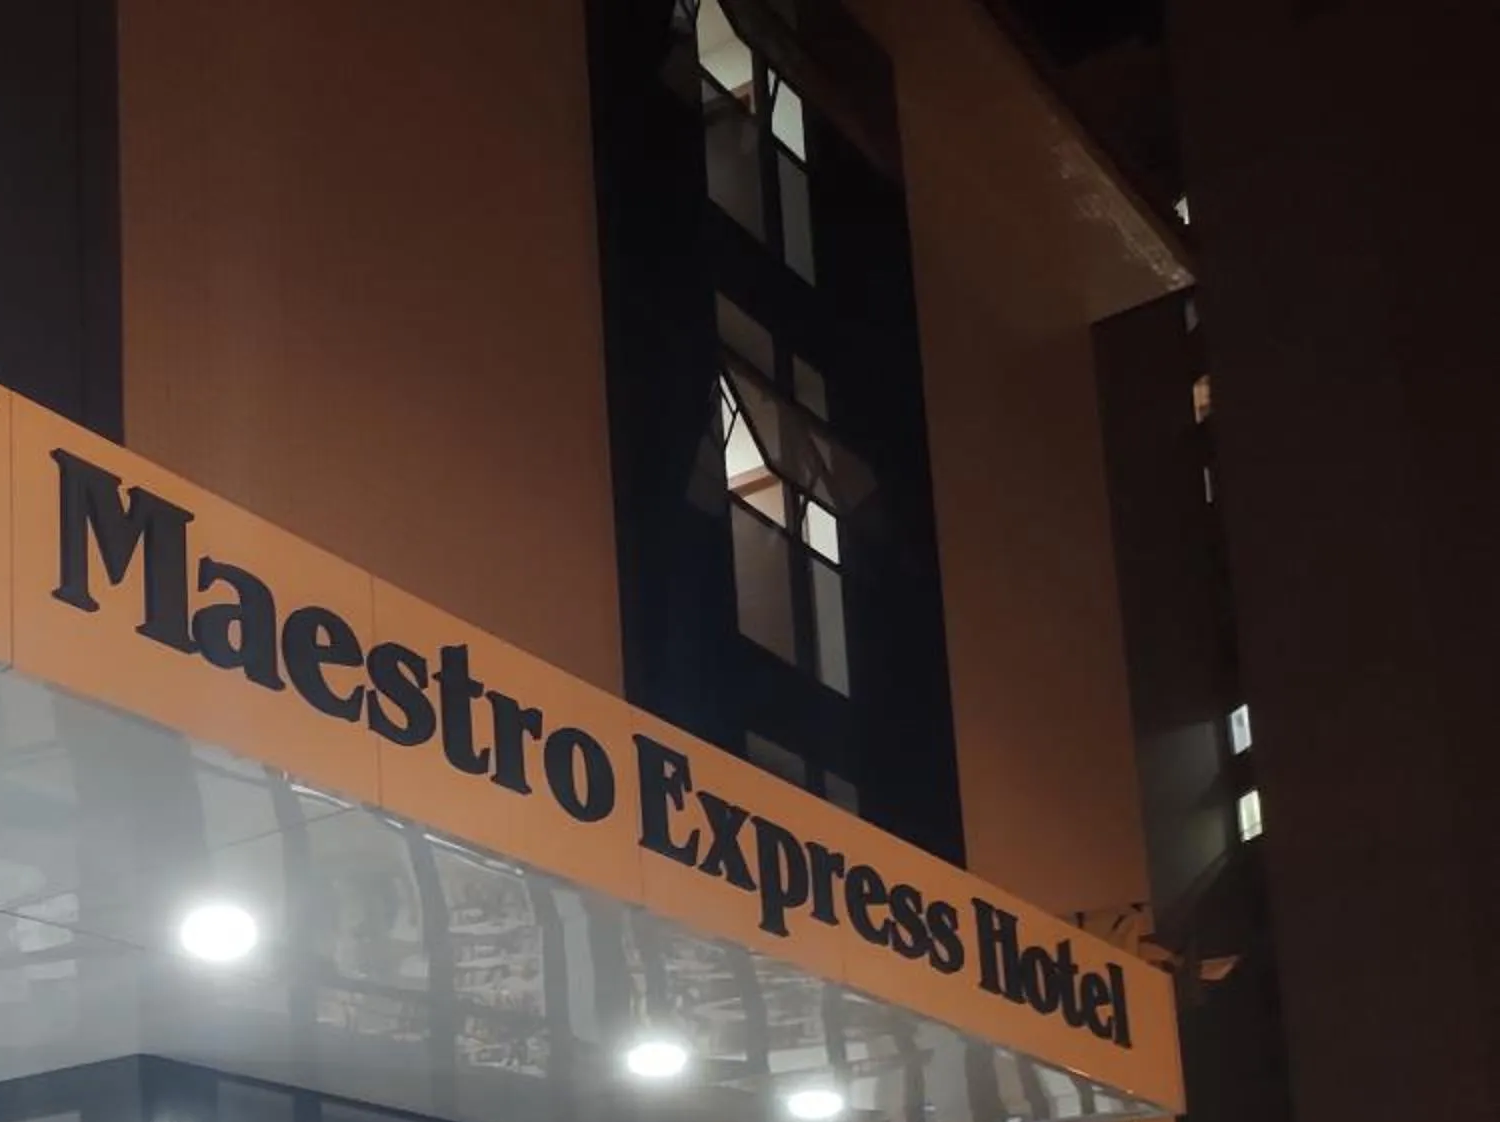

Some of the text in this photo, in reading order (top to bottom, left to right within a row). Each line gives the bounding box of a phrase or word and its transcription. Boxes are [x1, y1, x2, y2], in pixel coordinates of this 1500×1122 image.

[50, 447, 1132, 1050] Maestro Express Hotel
